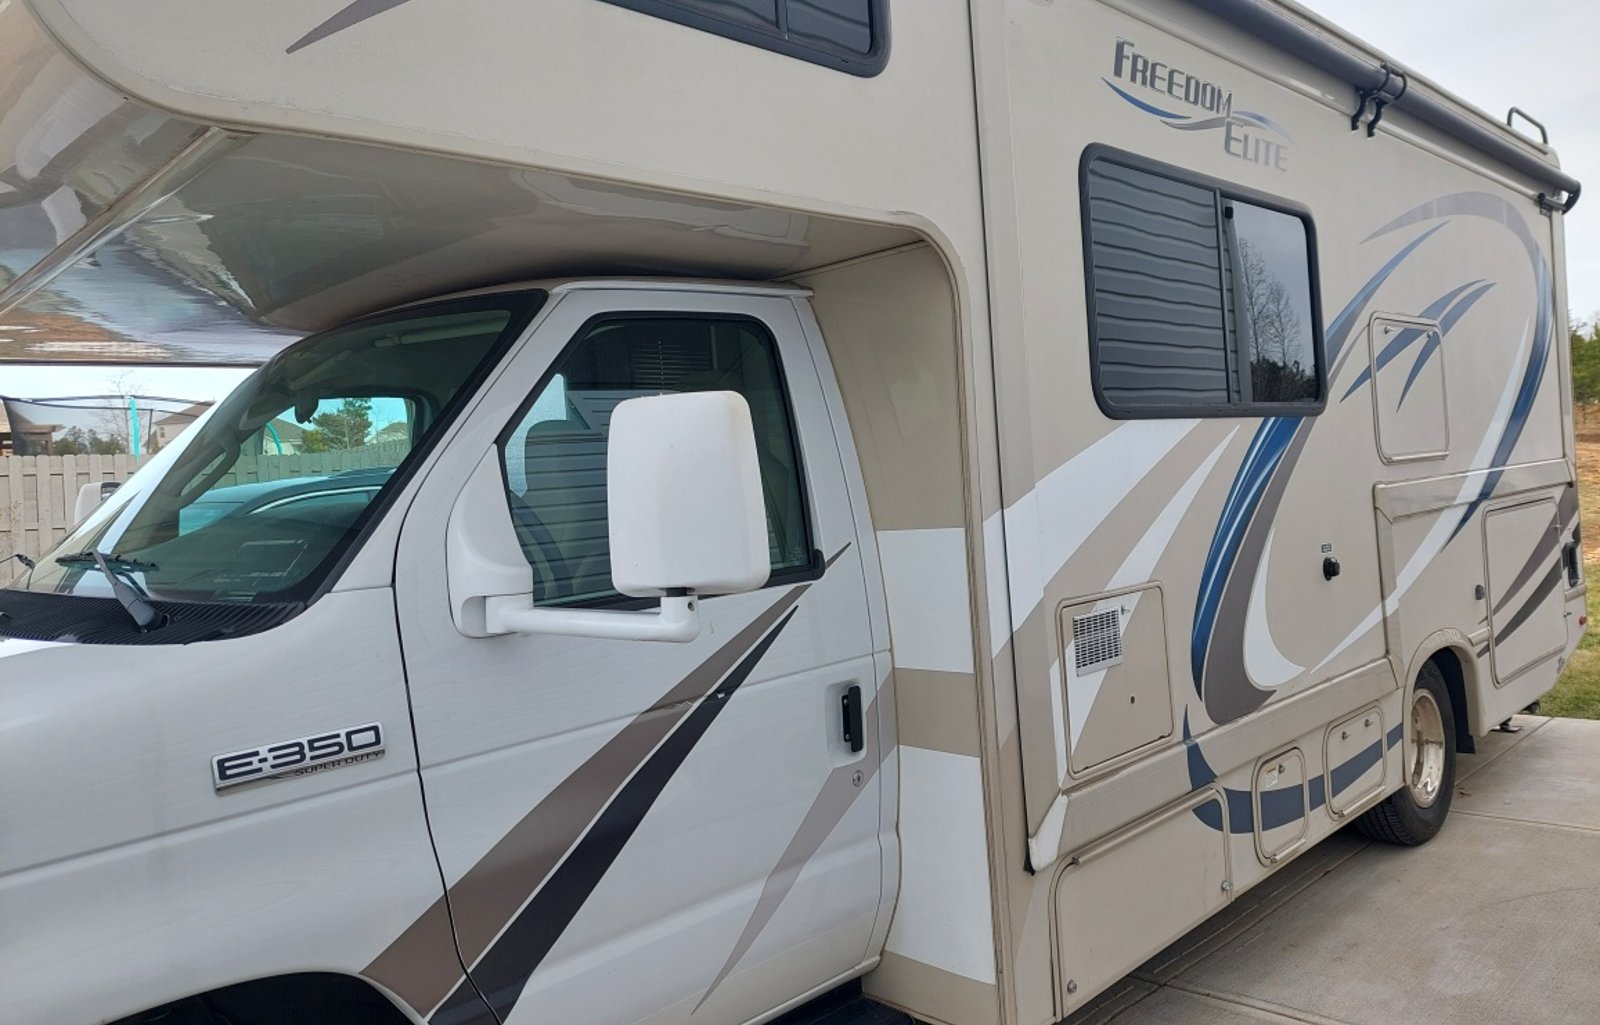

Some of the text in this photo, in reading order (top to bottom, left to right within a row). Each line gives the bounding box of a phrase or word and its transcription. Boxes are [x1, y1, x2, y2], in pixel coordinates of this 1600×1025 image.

[1113, 36, 1232, 118] FREEDOM
[1224, 120, 1288, 172] ELITE
[216, 725, 382, 780] E-350
[295, 751, 380, 776] SUPER DUTY
